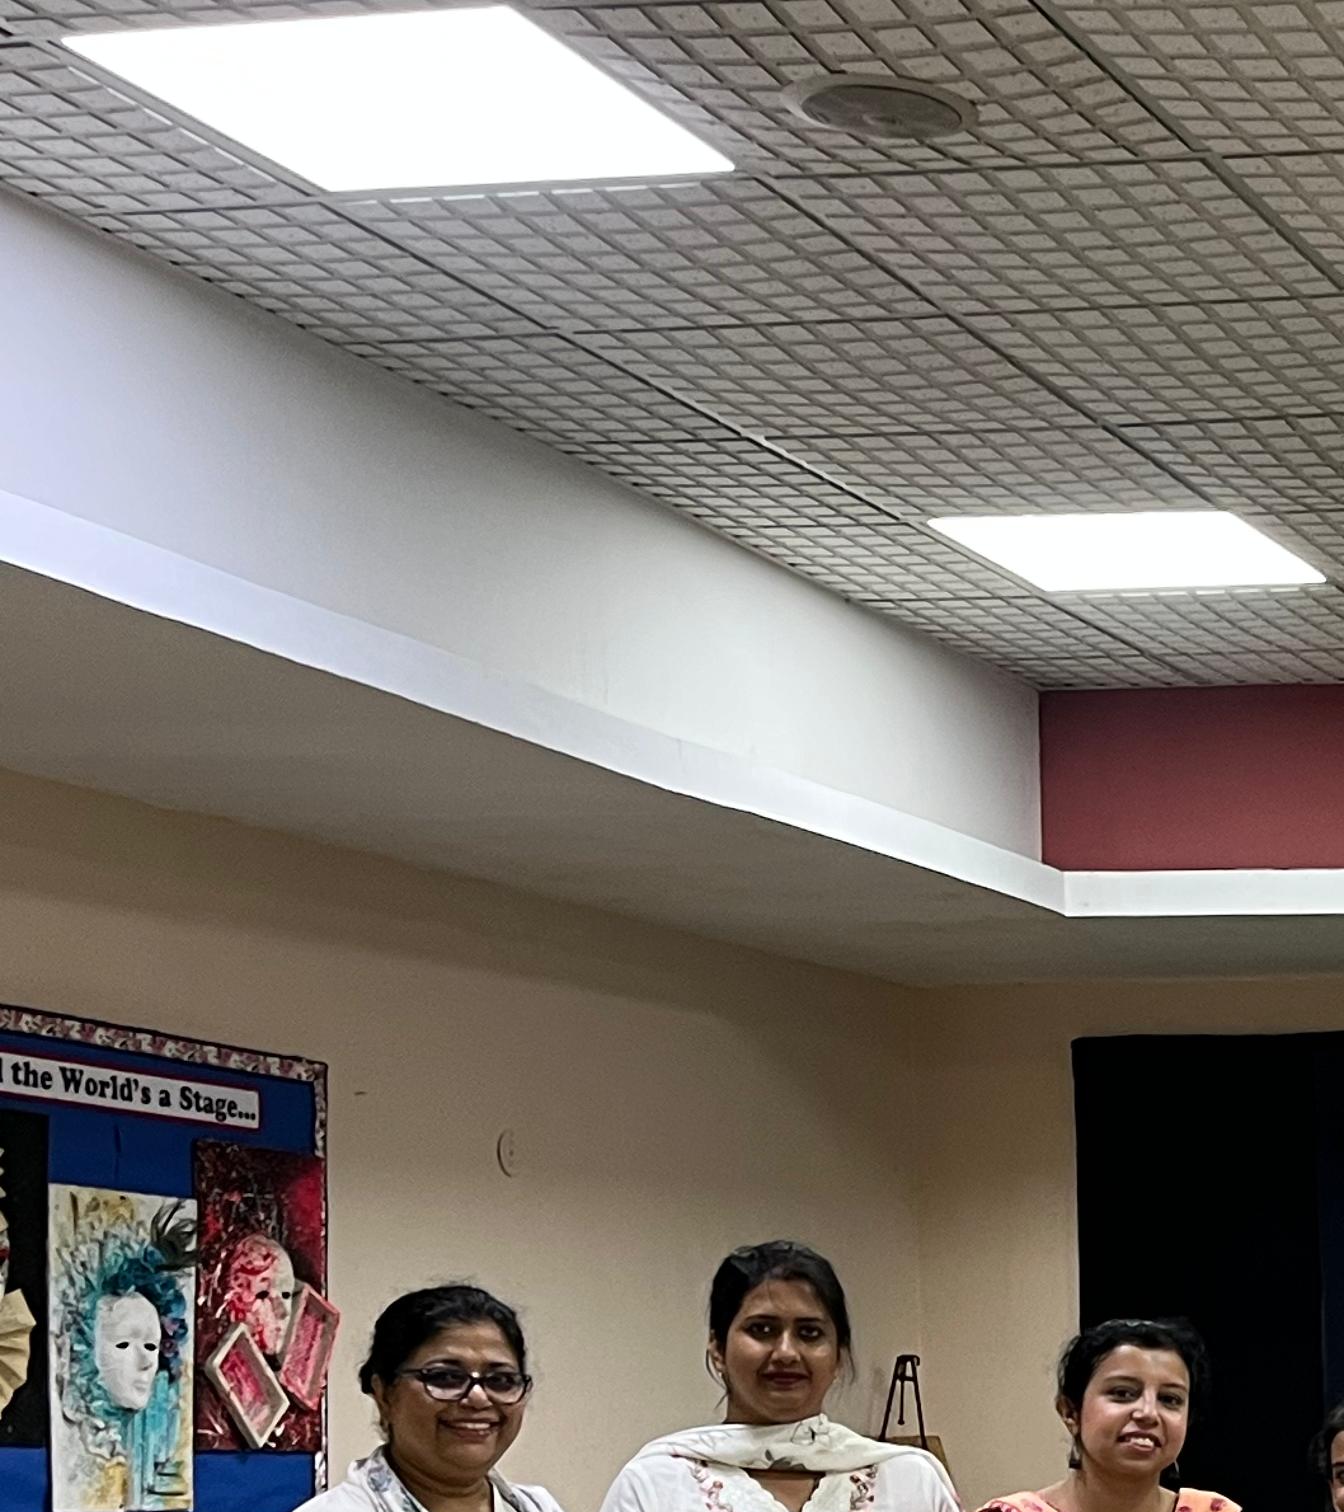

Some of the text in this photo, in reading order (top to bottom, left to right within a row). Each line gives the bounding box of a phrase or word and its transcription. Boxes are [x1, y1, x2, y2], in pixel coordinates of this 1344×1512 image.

[11, 1061, 53, 1090] the
[58, 1066, 151, 1105] World's
[158, 1089, 171, 1107] a
[179, 1086, 256, 1122] Stage...
